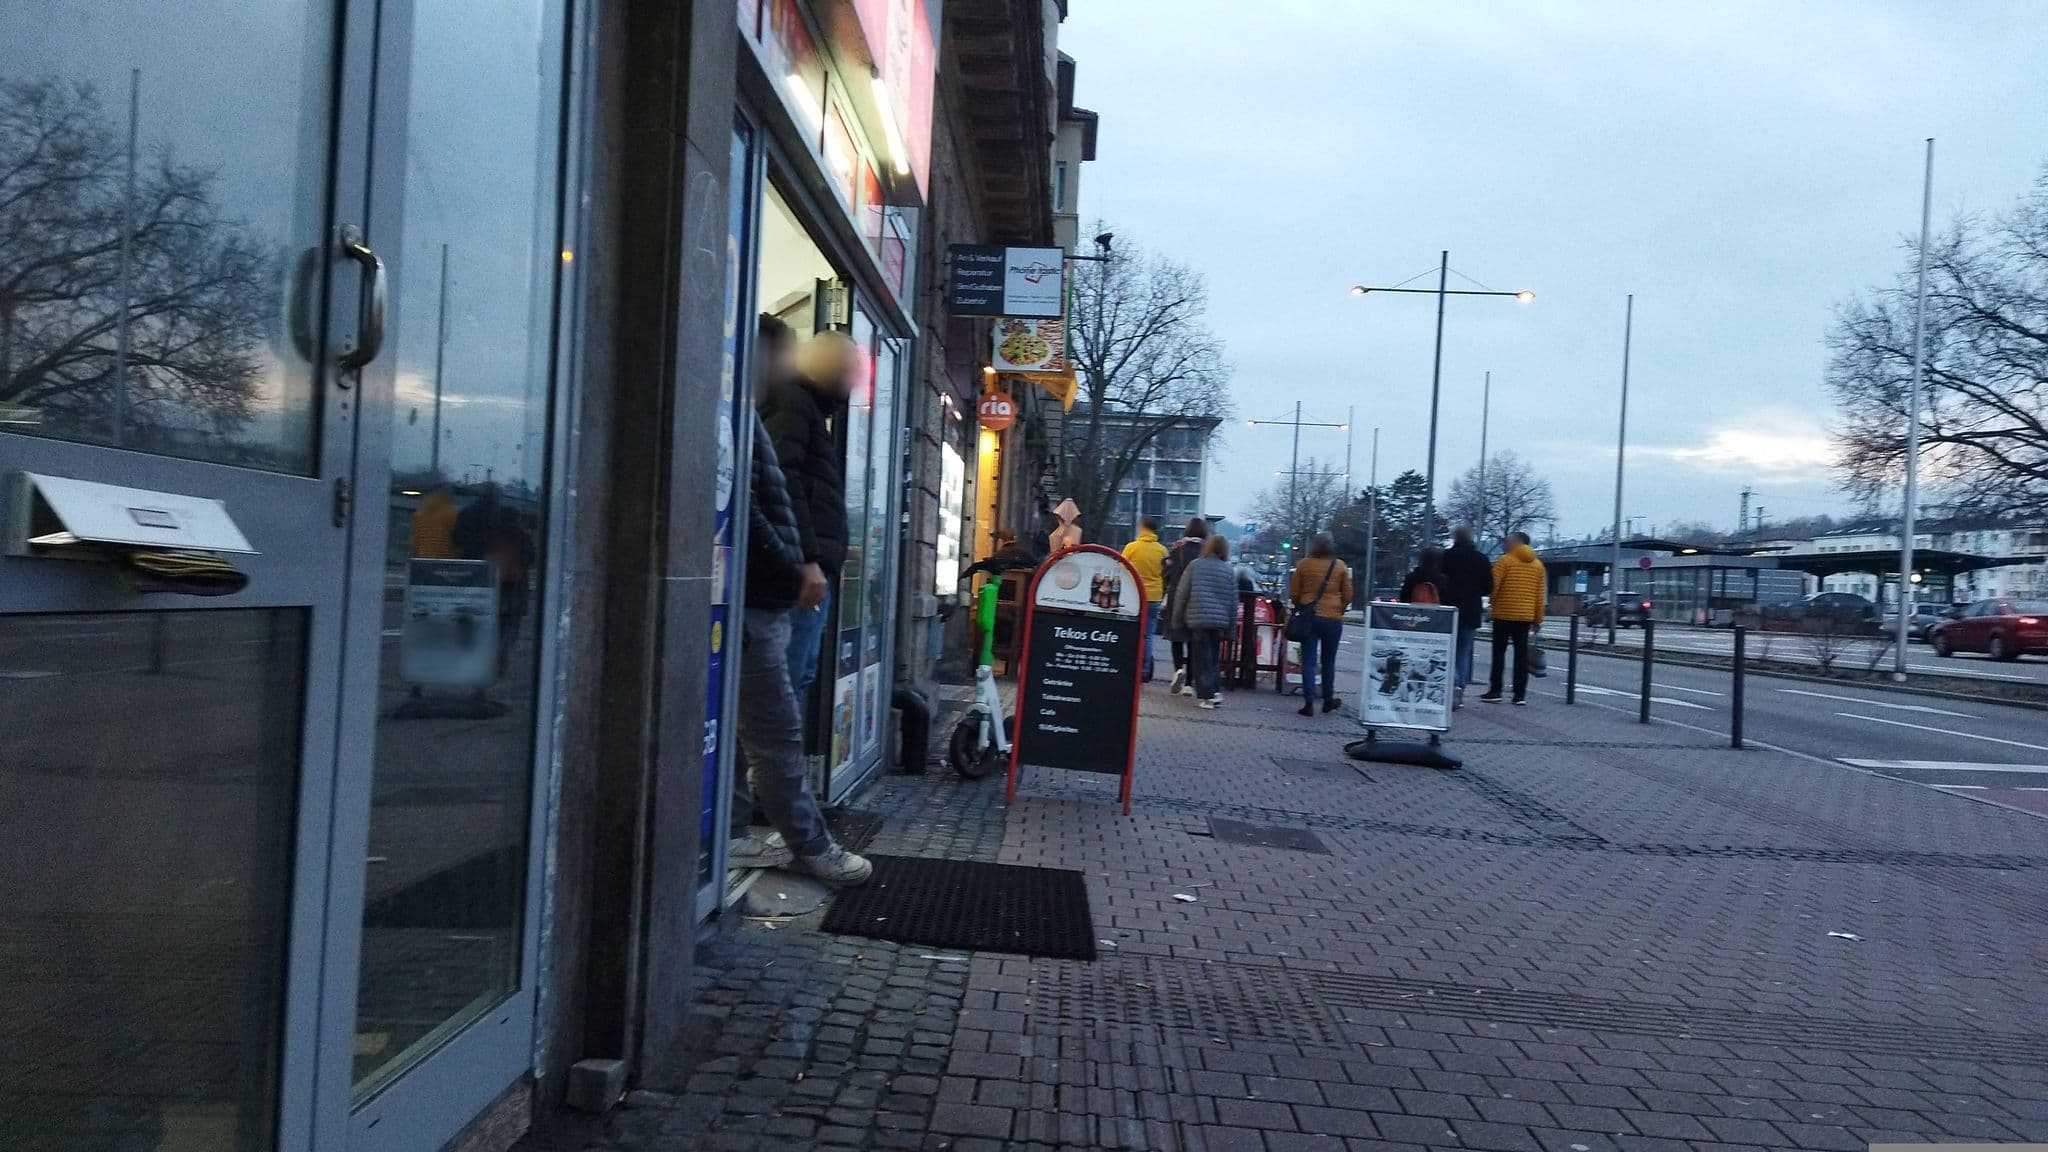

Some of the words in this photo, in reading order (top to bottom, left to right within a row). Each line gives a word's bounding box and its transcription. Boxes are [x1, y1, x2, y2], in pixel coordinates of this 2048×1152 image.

[980, 395, 1011, 415] ria
[1053, 626, 1088, 640] Tekos
[1090, 630, 1119, 643] Cafe
